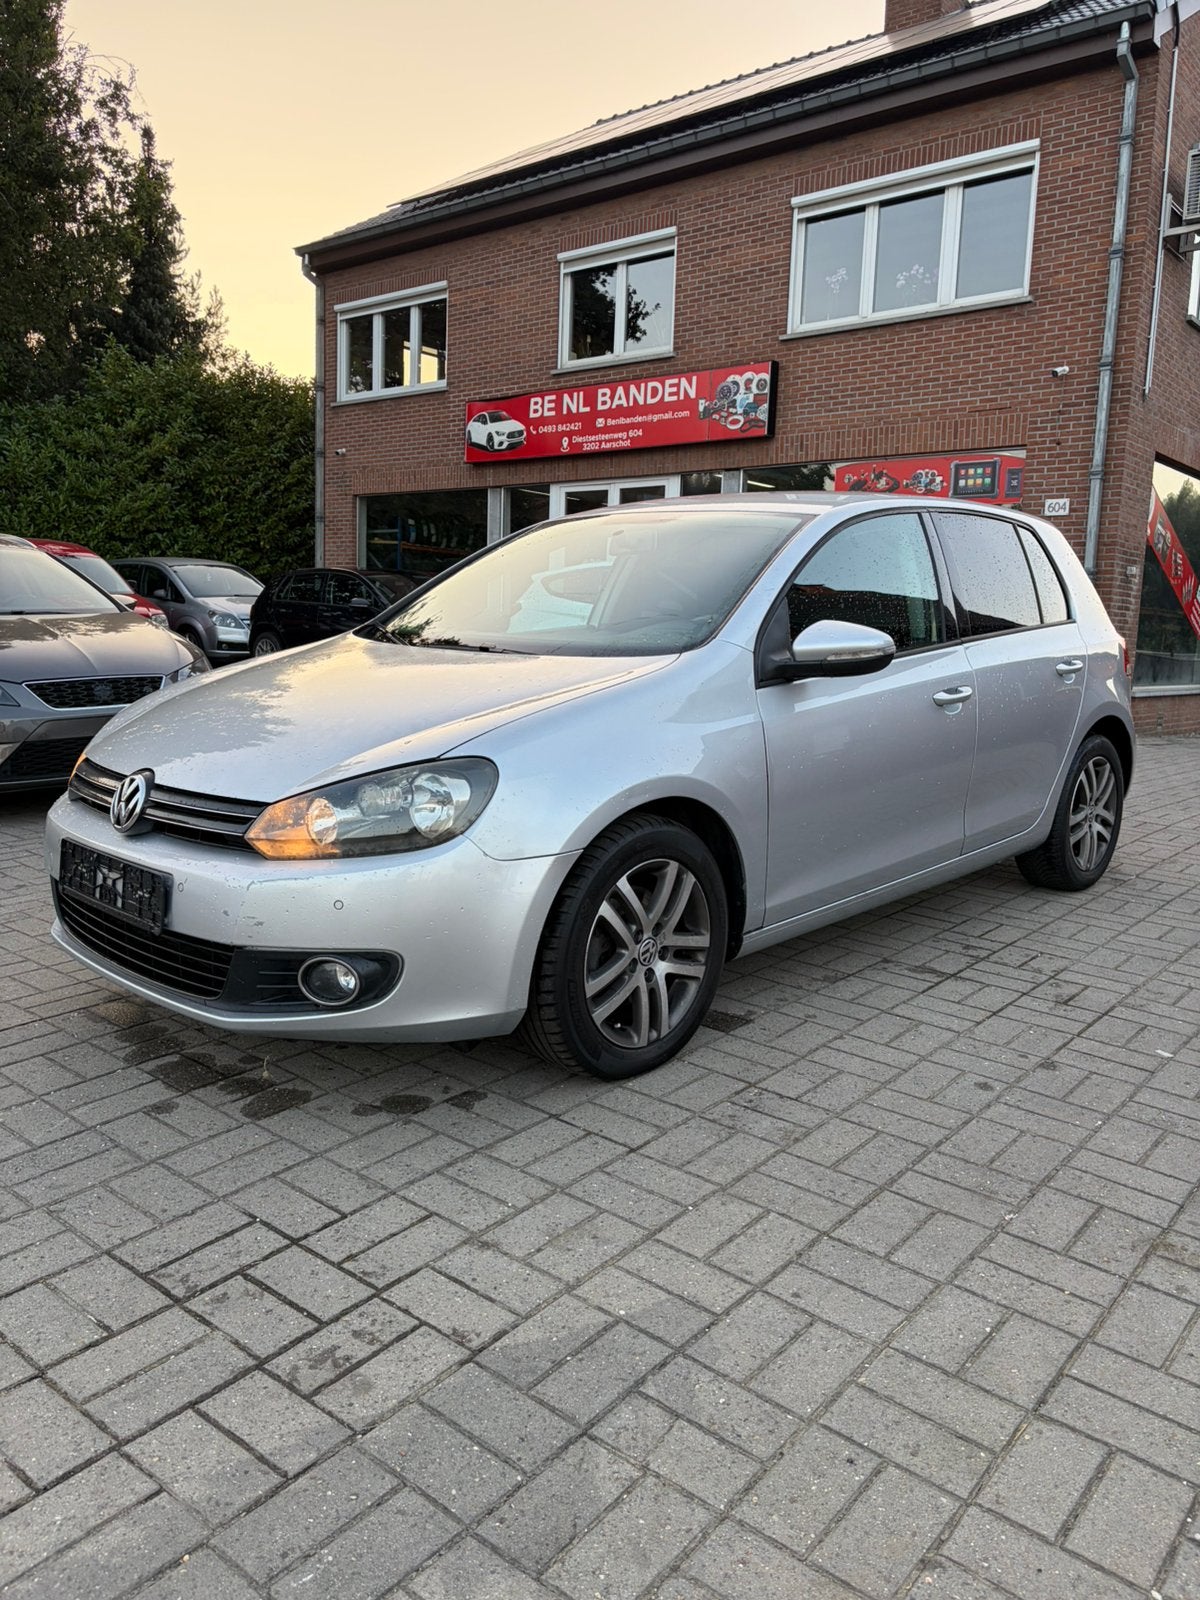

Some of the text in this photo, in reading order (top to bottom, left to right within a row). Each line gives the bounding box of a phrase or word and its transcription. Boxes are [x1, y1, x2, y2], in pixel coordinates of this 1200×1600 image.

[529, 376, 697, 419] BE NL BANDEN
[606, 410, 690, 426] Benlbanden@gmail.com
[538, 422, 582, 434] 0493 842421
[572, 428, 643, 443] Diestsesteenweg 604
[582, 439, 631, 451] 3202 Aarschot
[1047, 501, 1067, 513] 604
[110, 774, 146, 833] VW
